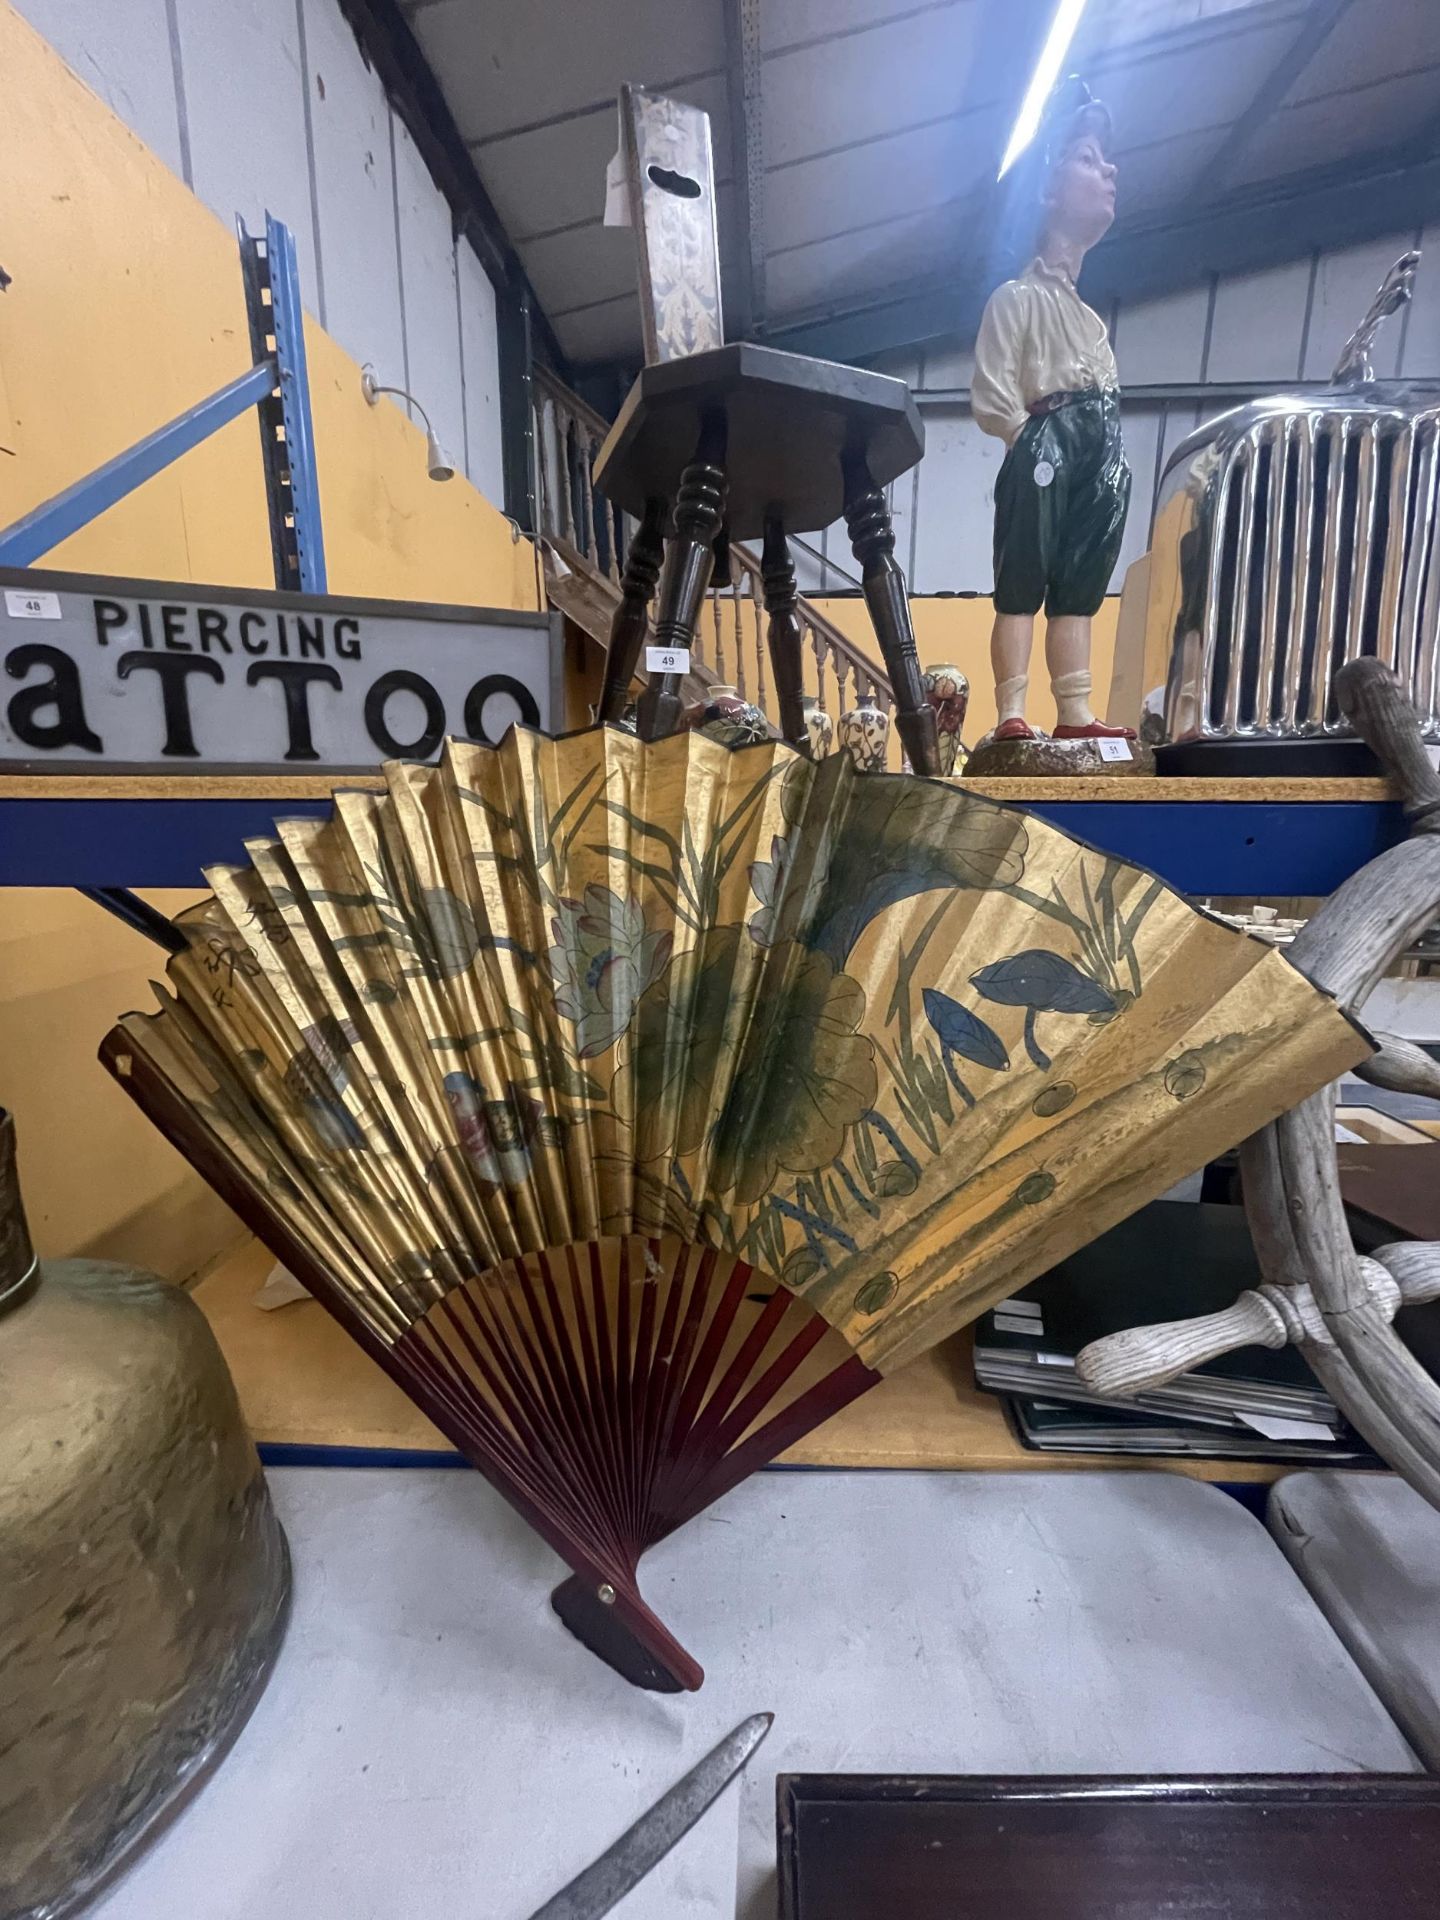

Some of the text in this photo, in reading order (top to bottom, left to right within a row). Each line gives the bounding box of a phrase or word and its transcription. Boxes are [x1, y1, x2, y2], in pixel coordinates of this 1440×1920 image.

[25, 600, 41, 611] 48
[93, 599, 362, 660] PIERCING
[662, 656, 675, 666] 49
[1109, 745, 1119, 755] 51
